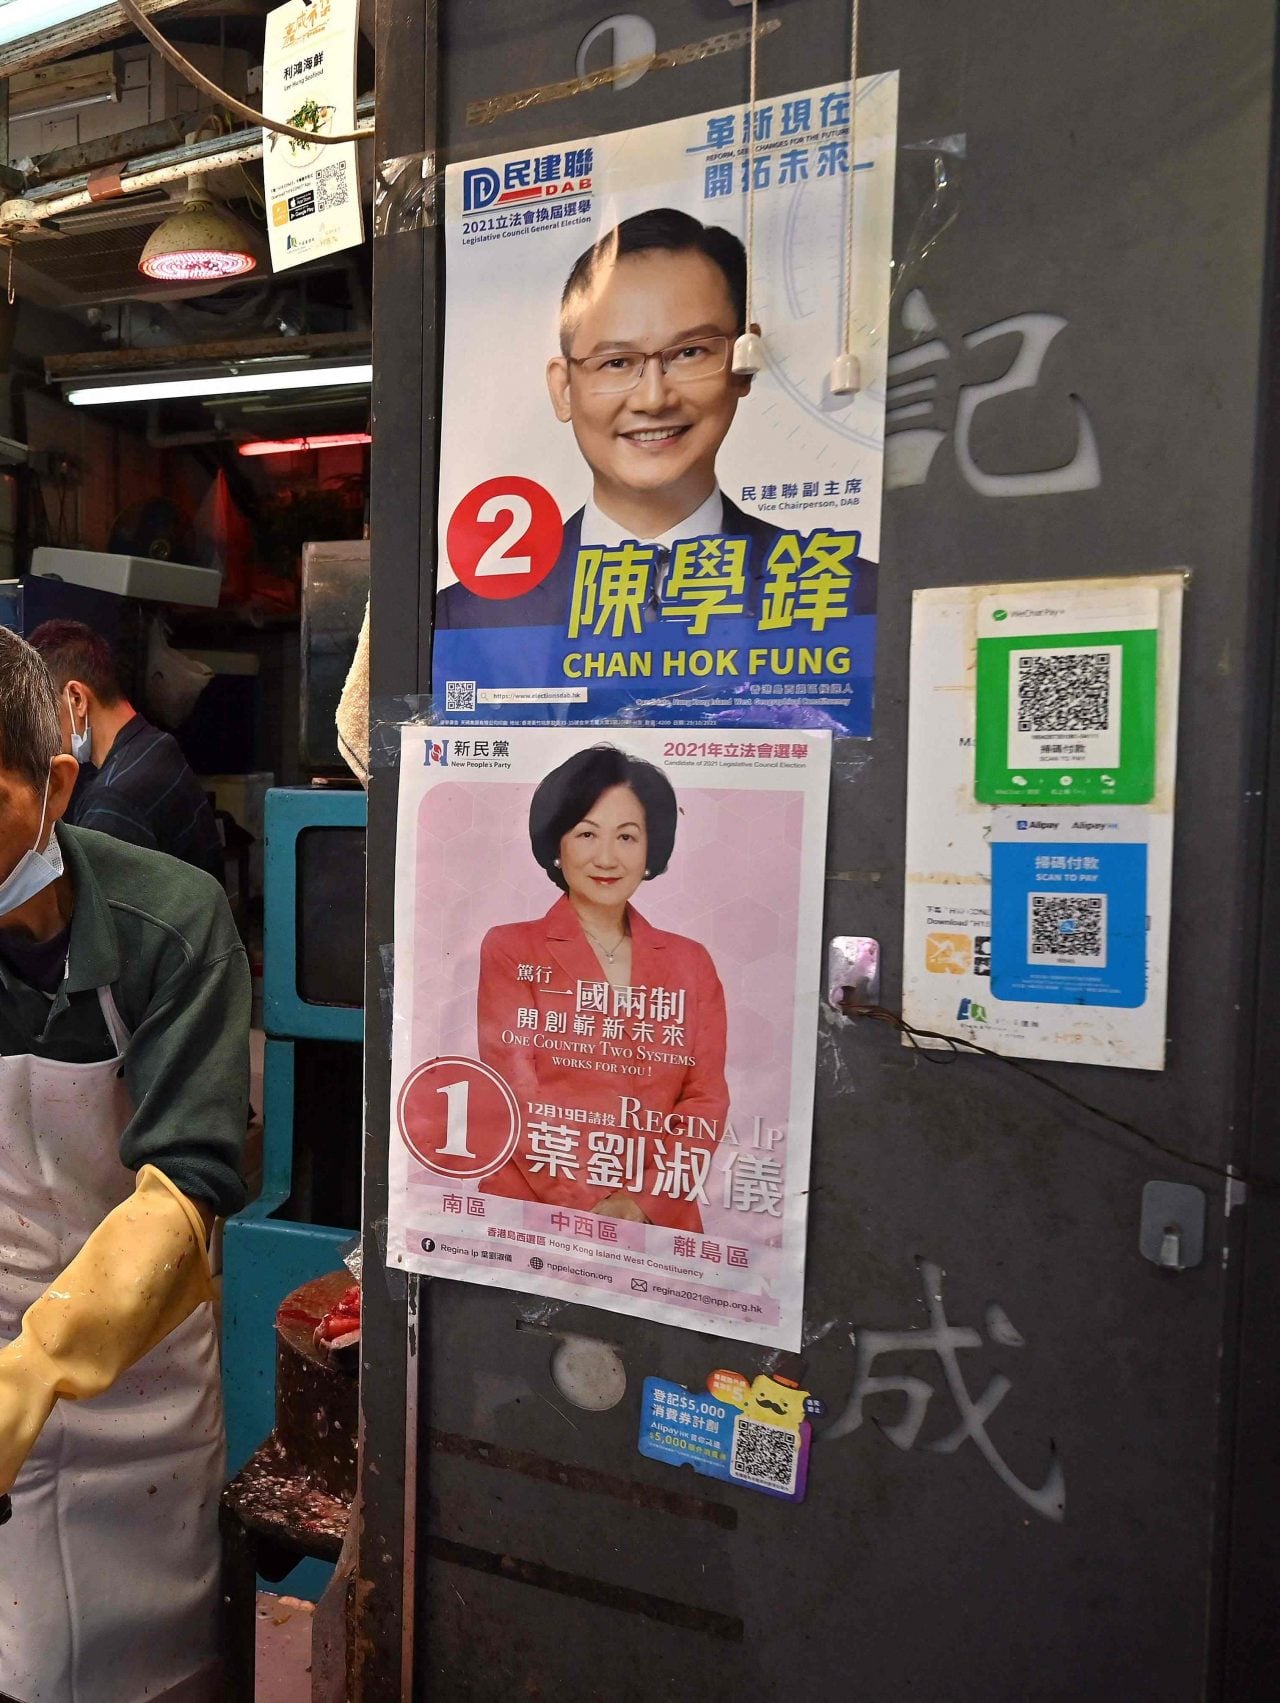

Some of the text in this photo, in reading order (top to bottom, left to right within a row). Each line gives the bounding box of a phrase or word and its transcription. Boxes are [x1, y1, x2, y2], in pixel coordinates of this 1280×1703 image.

[283, 50, 324, 80] 利鴻海鮮
[706, 91, 850, 149] 革新現在
[789, 136, 805, 146] FOR
[806, 133, 819, 142] THE
[504, 148, 593, 190] 民建聯
[704, 141, 850, 198] 開拓未來
[545, 178, 592, 196] DAB
[462, 215, 592, 246] Legislative Council General Election
[463, 199, 592, 235] 2021立法會換屆選舉
[741, 478, 862, 501] 民建聯副主席
[758, 498, 860, 511] Vice Chairperson, DAB
[475, 494, 533, 577] 2
[567, 532, 856, 639] 陳學鋒
[562, 646, 851, 678] CHAN HOK FUNG
[454, 740, 509, 757] 新民黨
[663, 742, 808, 759] 2021年立法會選舉
[466, 761, 492, 769] People's
[1035, 873, 1062, 881] SCAN
[517, 963, 552, 984] 篤行
[539, 979, 686, 1024] 一國兩制
[517, 1008, 685, 1047] 開創嶄新未來
[552, 1056, 592, 1069] WORKS
[595, 1061, 618, 1073] FOR
[435, 1080, 477, 1159] 1
[526, 1121, 784, 1217] 葉劉淑儀
[442, 1193, 486, 1217] 南區
[550, 1211, 618, 1243] 中西區
[440, 1243, 469, 1257] Regina
[549, 1239, 571, 1252] Hong
[572, 1243, 594, 1257] Kong
[595, 1248, 621, 1261] Island
[623, 1254, 645, 1266] West
[646, 1259, 704, 1279] Constituency
[673, 1235, 750, 1269] 離島區
[546, 1262, 613, 1283] nppelection.org
[652, 1285, 763, 1314] regina2021@npp.org.hk
